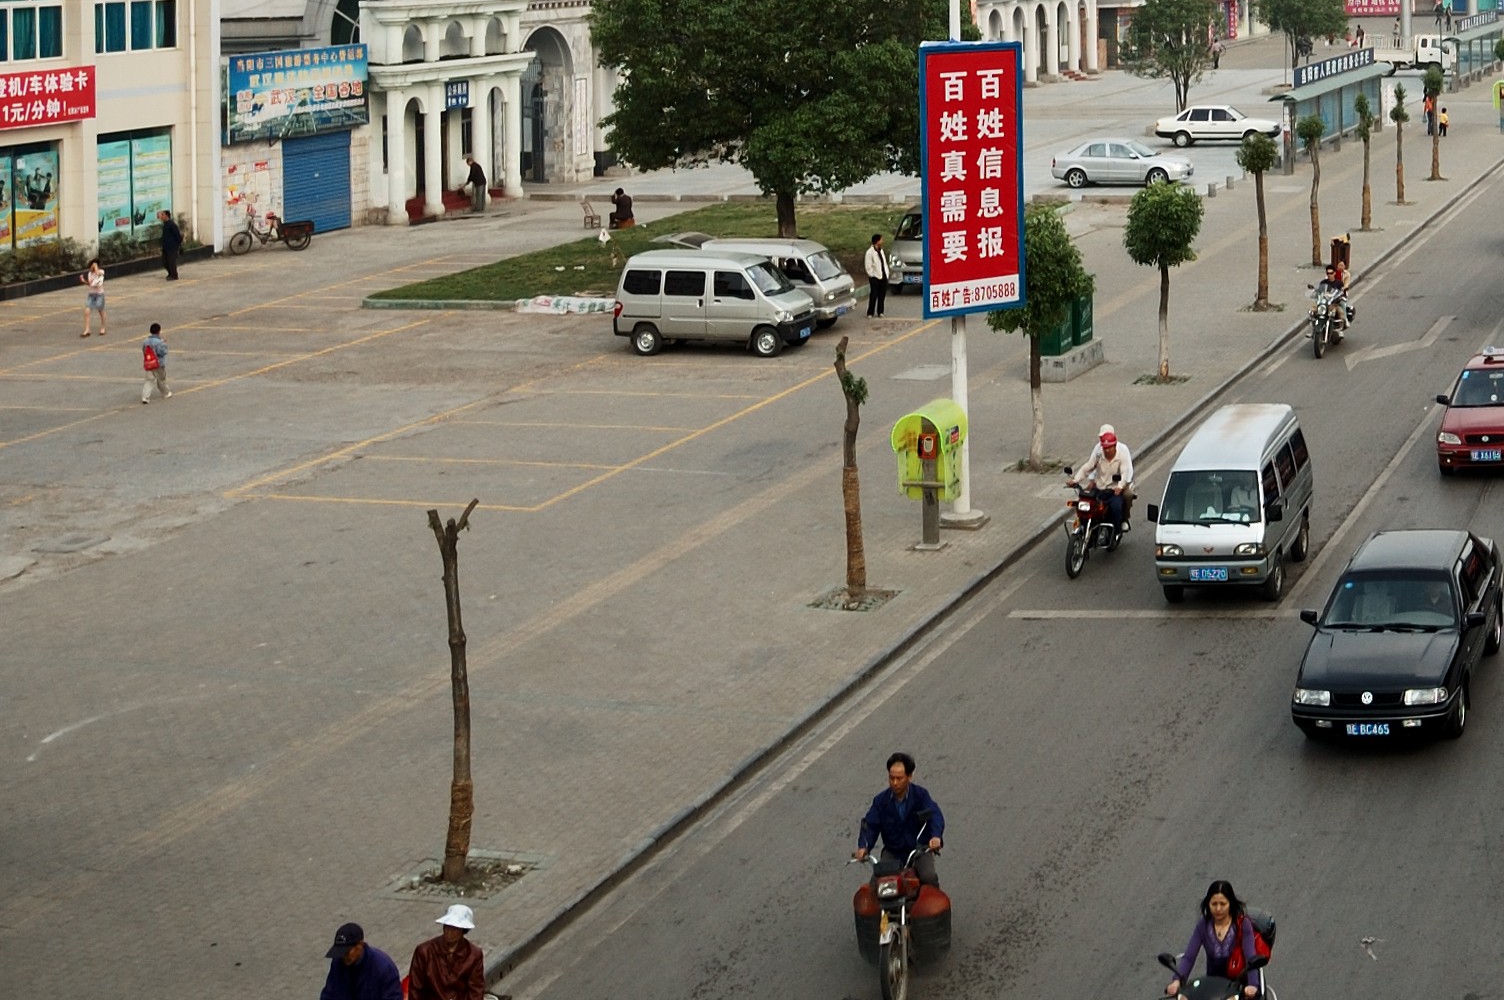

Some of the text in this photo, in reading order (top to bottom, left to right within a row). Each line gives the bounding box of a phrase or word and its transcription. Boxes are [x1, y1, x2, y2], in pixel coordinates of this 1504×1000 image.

[939, 71, 968, 263] 百姓真需要
[976, 68, 1005, 259] 百姓信息报
[930, 282, 1016, 310] 百姓广告:8705888
[1360, 723, 1390, 735] BC465
